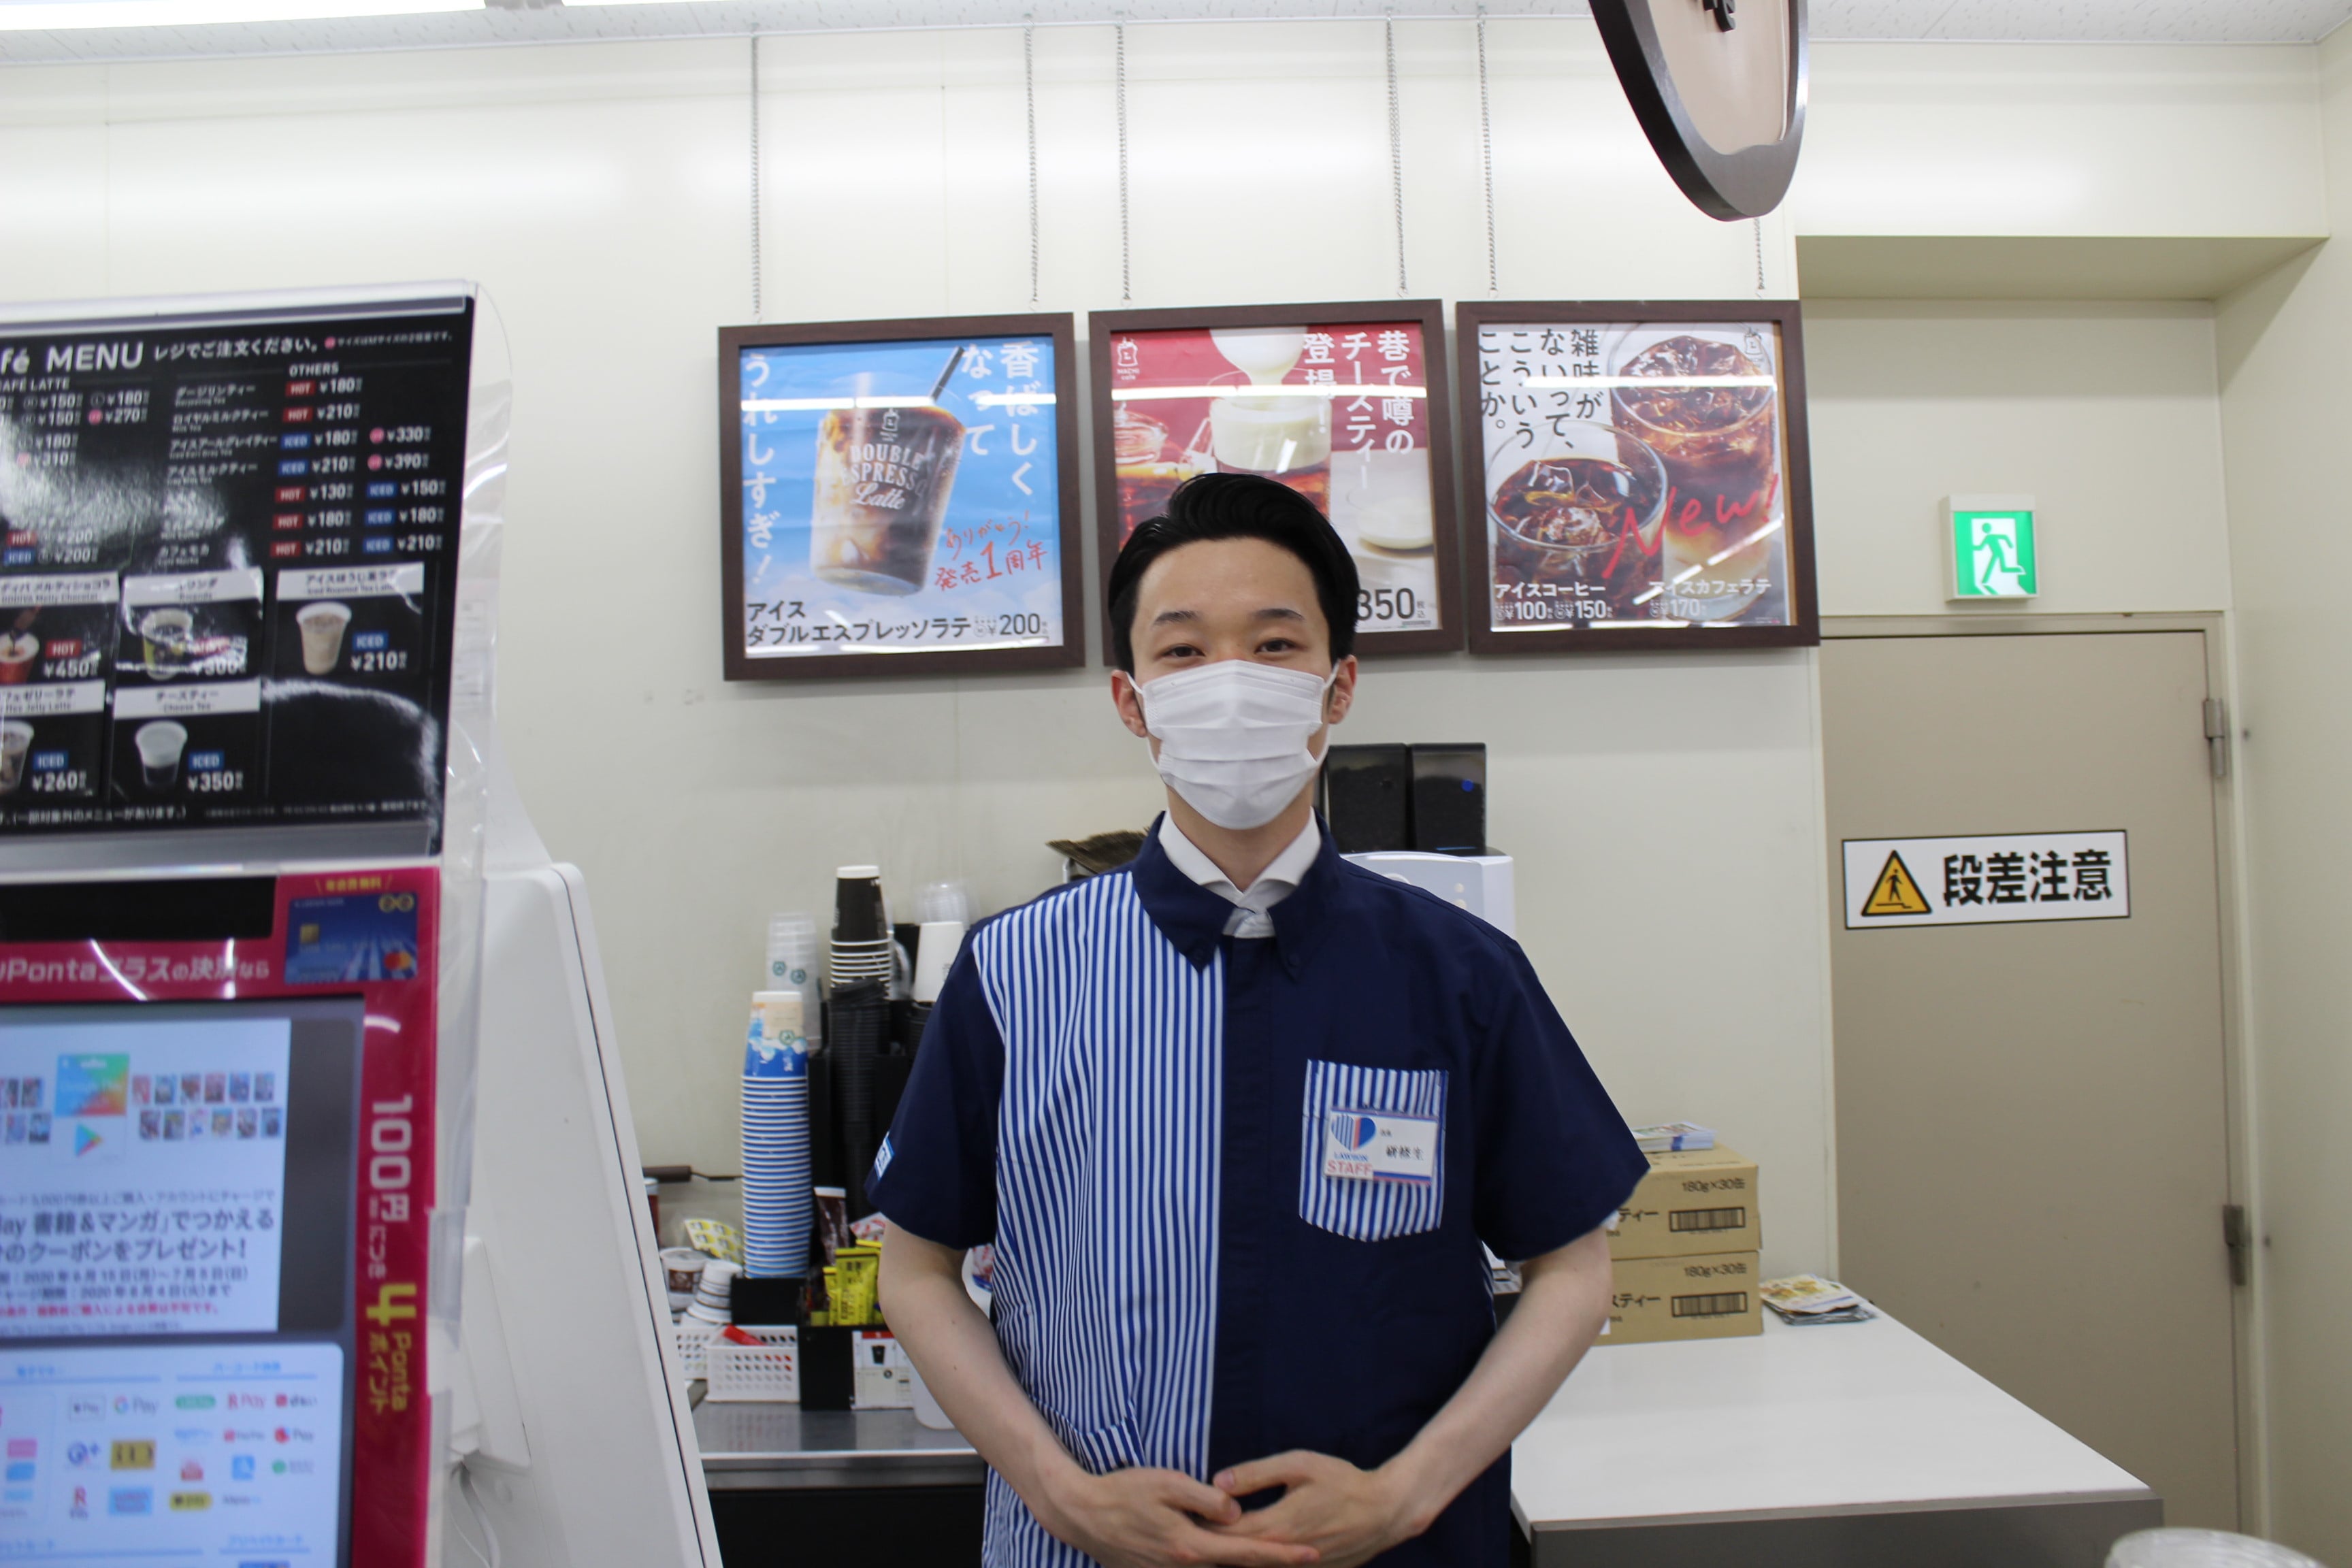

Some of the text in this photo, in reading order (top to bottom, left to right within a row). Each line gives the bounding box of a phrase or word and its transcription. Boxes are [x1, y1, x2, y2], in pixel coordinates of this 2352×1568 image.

[46, 342, 144, 373] MENU
[154, 338, 317, 361] レジでご注文ください。
[289, 362, 339, 378] OTHERS
[1479, 331, 1507, 429] ことか。
[0, 378, 27, 393] AFÉ
[291, 382, 311, 394] HOT
[961, 344, 996, 455] なって
[288, 410, 308, 421] HOT
[999, 340, 1041, 497] 香ばしく
[850, 444, 924, 471] DOUBLE
[282, 462, 305, 474] ICED
[280, 489, 301, 500] HOT
[370, 483, 394, 495] ICED
[851, 481, 906, 510] Latte
[278, 516, 299, 527] HOT
[368, 512, 392, 523] ICED
[1601, 473, 1779, 578] New!
[13, 534, 33, 544] HOT
[276, 543, 297, 555] HOT
[366, 538, 390, 550] ICED
[9, 551, 32, 563] ICED
[1495, 582, 1606, 599] アイスコーヒー
[747, 600, 806, 622] アイス
[747, 617, 971, 647] ダブルエスプレッソラテ
[53, 644, 76, 655] HOT
[356, 636, 385, 649] ICED
[351, 652, 397, 672] ¥210
[39, 755, 220, 768] ICED ICED
[33, 770, 233, 793] ¥260 ¥350
[1942, 848, 2112, 907] 段差注意
[1327, 1160, 1373, 1176] STAFF
[365, 1283, 418, 1326] 4
[368, 1333, 390, 1414] ポイント
[391, 1331, 412, 1411] Ponta
